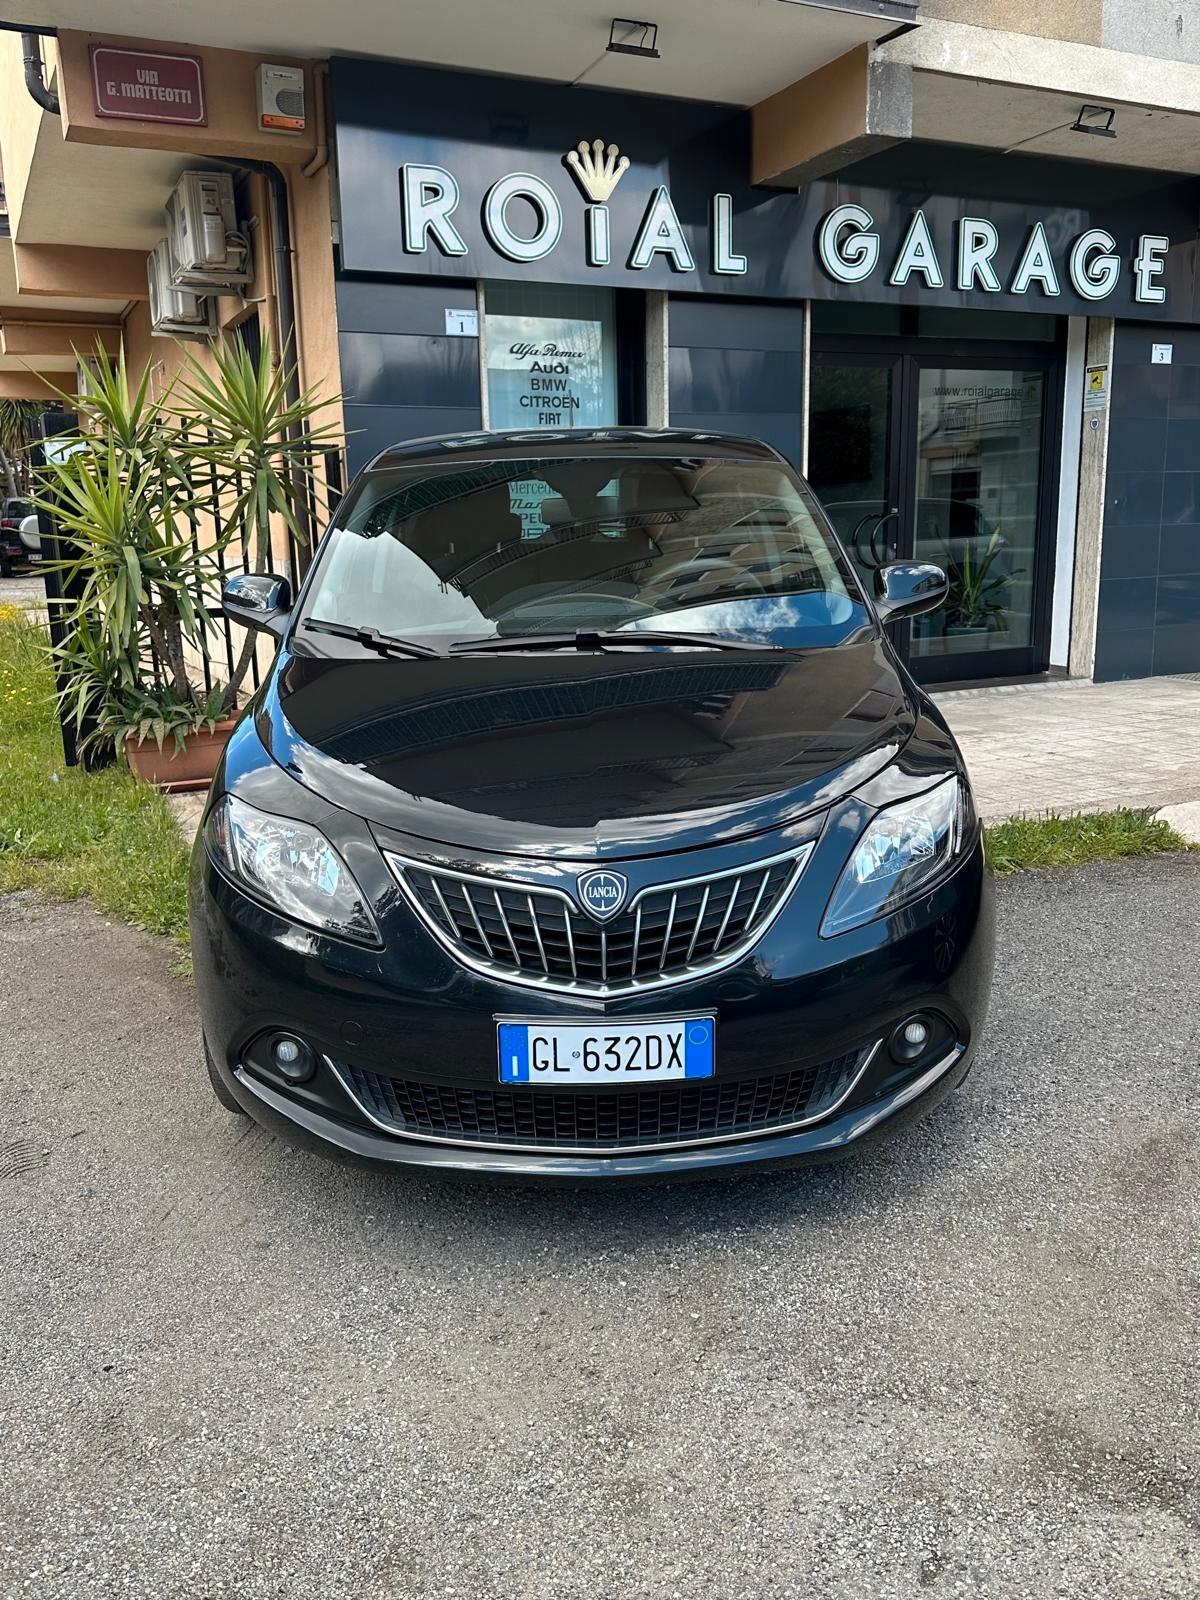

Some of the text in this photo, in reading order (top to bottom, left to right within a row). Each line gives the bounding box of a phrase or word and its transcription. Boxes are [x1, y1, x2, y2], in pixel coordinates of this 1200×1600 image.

[136, 69, 159, 85] VIA
[106, 81, 192, 104] G. MATTEOTTI
[401, 162, 1169, 304] ROIAL GARAGE
[459, 321, 464, 333] 1
[509, 342, 586, 361] Alfa Romeo
[1159, 352, 1164, 362] 3
[529, 361, 569, 375] Audi
[531, 378, 567, 392] BMW
[519, 394, 580, 409] CITROËN
[538, 412, 562, 425] FIAT
[588, 886, 618, 898] LANCIA
